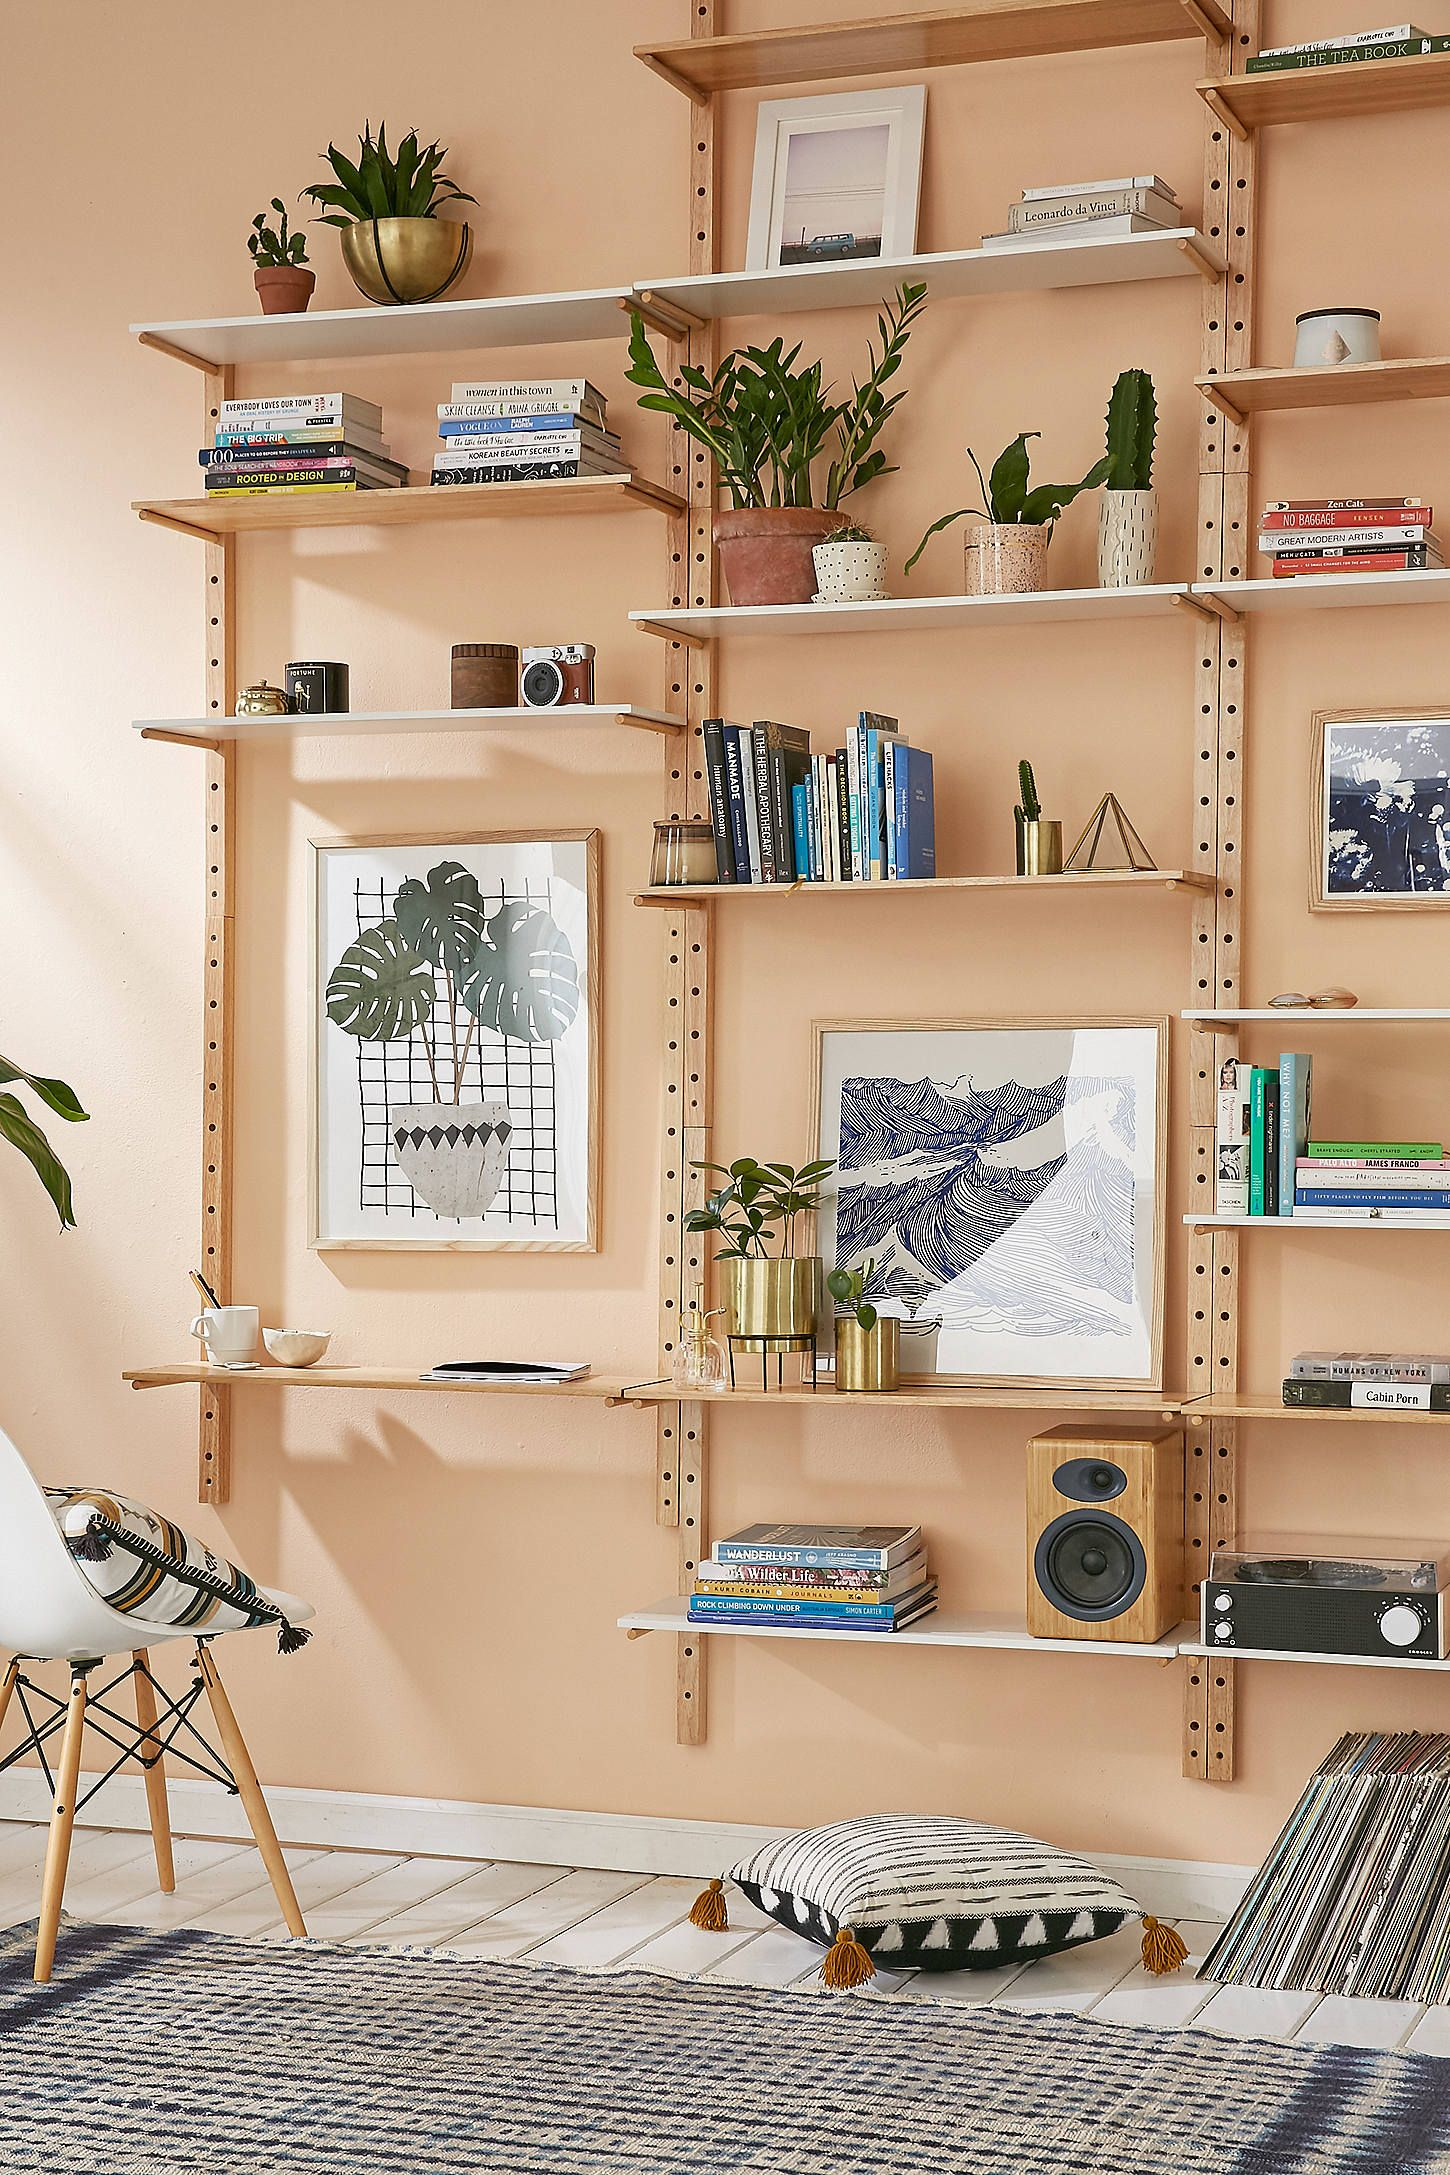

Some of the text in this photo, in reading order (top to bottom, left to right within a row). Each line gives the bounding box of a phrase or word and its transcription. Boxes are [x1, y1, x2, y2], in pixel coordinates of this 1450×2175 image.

[1296, 53, 1327, 67] THE
[1330, 49, 1362, 63] TEA
[1364, 43, 1408, 60] BOOK
[1024, 206, 1074, 222] Leonardo
[1076, 203, 1088, 215] da
[1089, 200, 1116, 214] Vinci
[466, 386, 552, 397] women in this town
[226, 398, 312, 412] EVERYBODY LOVES OUR TOWN
[444, 402, 560, 416] SKIN CLEANSE ADINA GRIGORE
[460, 422, 490, 432] VOGUE
[227, 436, 245, 444] THE
[247, 434, 264, 444] BIG
[265, 433, 284, 442] TRIP
[208, 449, 234, 464] 100
[468, 451, 499, 460] KOREAN
[500, 448, 528, 458] BEAUTY
[530, 446, 560, 456] SECRETS
[236, 473, 278, 484] ROOTED
[286, 471, 324, 481] DESIGN
[1328, 500, 1344, 508] Zen
[1283, 514, 1296, 526] NO
[1299, 512, 1336, 526] BAGGAGE
[1278, 532, 1384, 546] GREAT MODERN ARTISTS
[726, 742, 740, 800] MANMADE
[714, 764, 726, 838] human anatomy
[755, 736, 772, 857] THE HERBAL APOTHECARY
[1282, 1092, 1290, 1112] NOT
[1282, 1120, 1290, 1138] ME?
[1332, 1367, 1366, 1375] HUMANS
[1405, 1369, 1426, 1377] YORK
[1366, 1390, 1418, 1404] Cabin Porn
[726, 1549, 801, 1562] WANDERLUST
[747, 1568, 789, 1581] Wilder
[792, 1568, 816, 1582] Life
[697, 1600, 717, 1608] ROCK
[718, 1602, 752, 1610] CLIMBING
[752, 1603, 774, 1611] DOWN
[776, 1604, 800, 1612] UNDER
